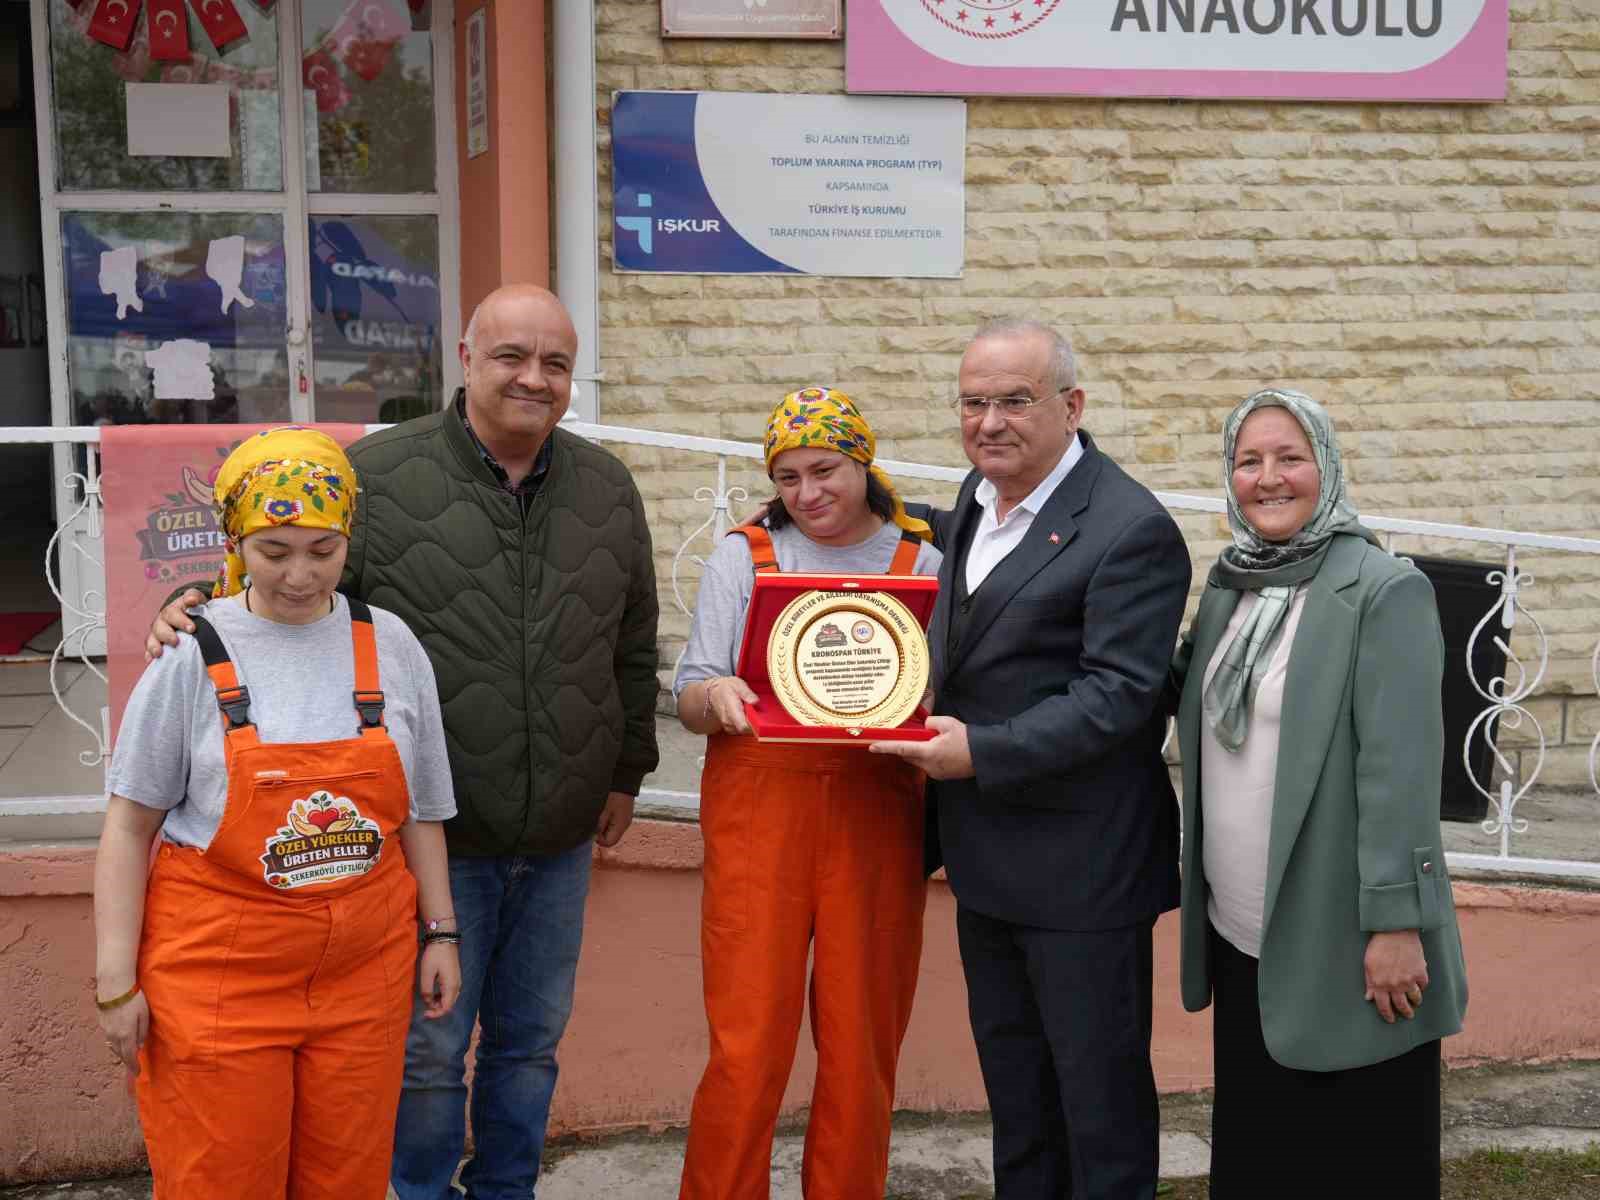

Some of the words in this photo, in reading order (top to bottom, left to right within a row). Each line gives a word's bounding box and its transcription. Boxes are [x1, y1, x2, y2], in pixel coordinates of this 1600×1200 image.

[1110, 0, 1443, 37] ANAOKULU
[805, 133, 819, 144] BU
[822, 134, 859, 145] ALANIN
[771, 157, 812, 167] TOPLUM
[816, 158, 864, 168] YARARINA
[866, 159, 915, 169] PROGRAM
[918, 159, 942, 171] (TYP)
[825, 181, 889, 192] KAPSAMINDA
[808, 203, 849, 214] TÜRKİYE
[862, 205, 906, 216] KURUMU
[769, 227, 830, 238] TARAFINDAN
[832, 227, 872, 238] FİNANSE
[157, 512, 206, 532] ÖZEL
[167, 531, 228, 551] ÜRETE
[854, 647, 882, 656] TÜRKİYE
[275, 841, 309, 855] ÖZEL
[310, 832, 374, 848] YÜREKLER
[283, 849, 331, 868] ÜRETEN
[333, 845, 368, 858] ELLER
